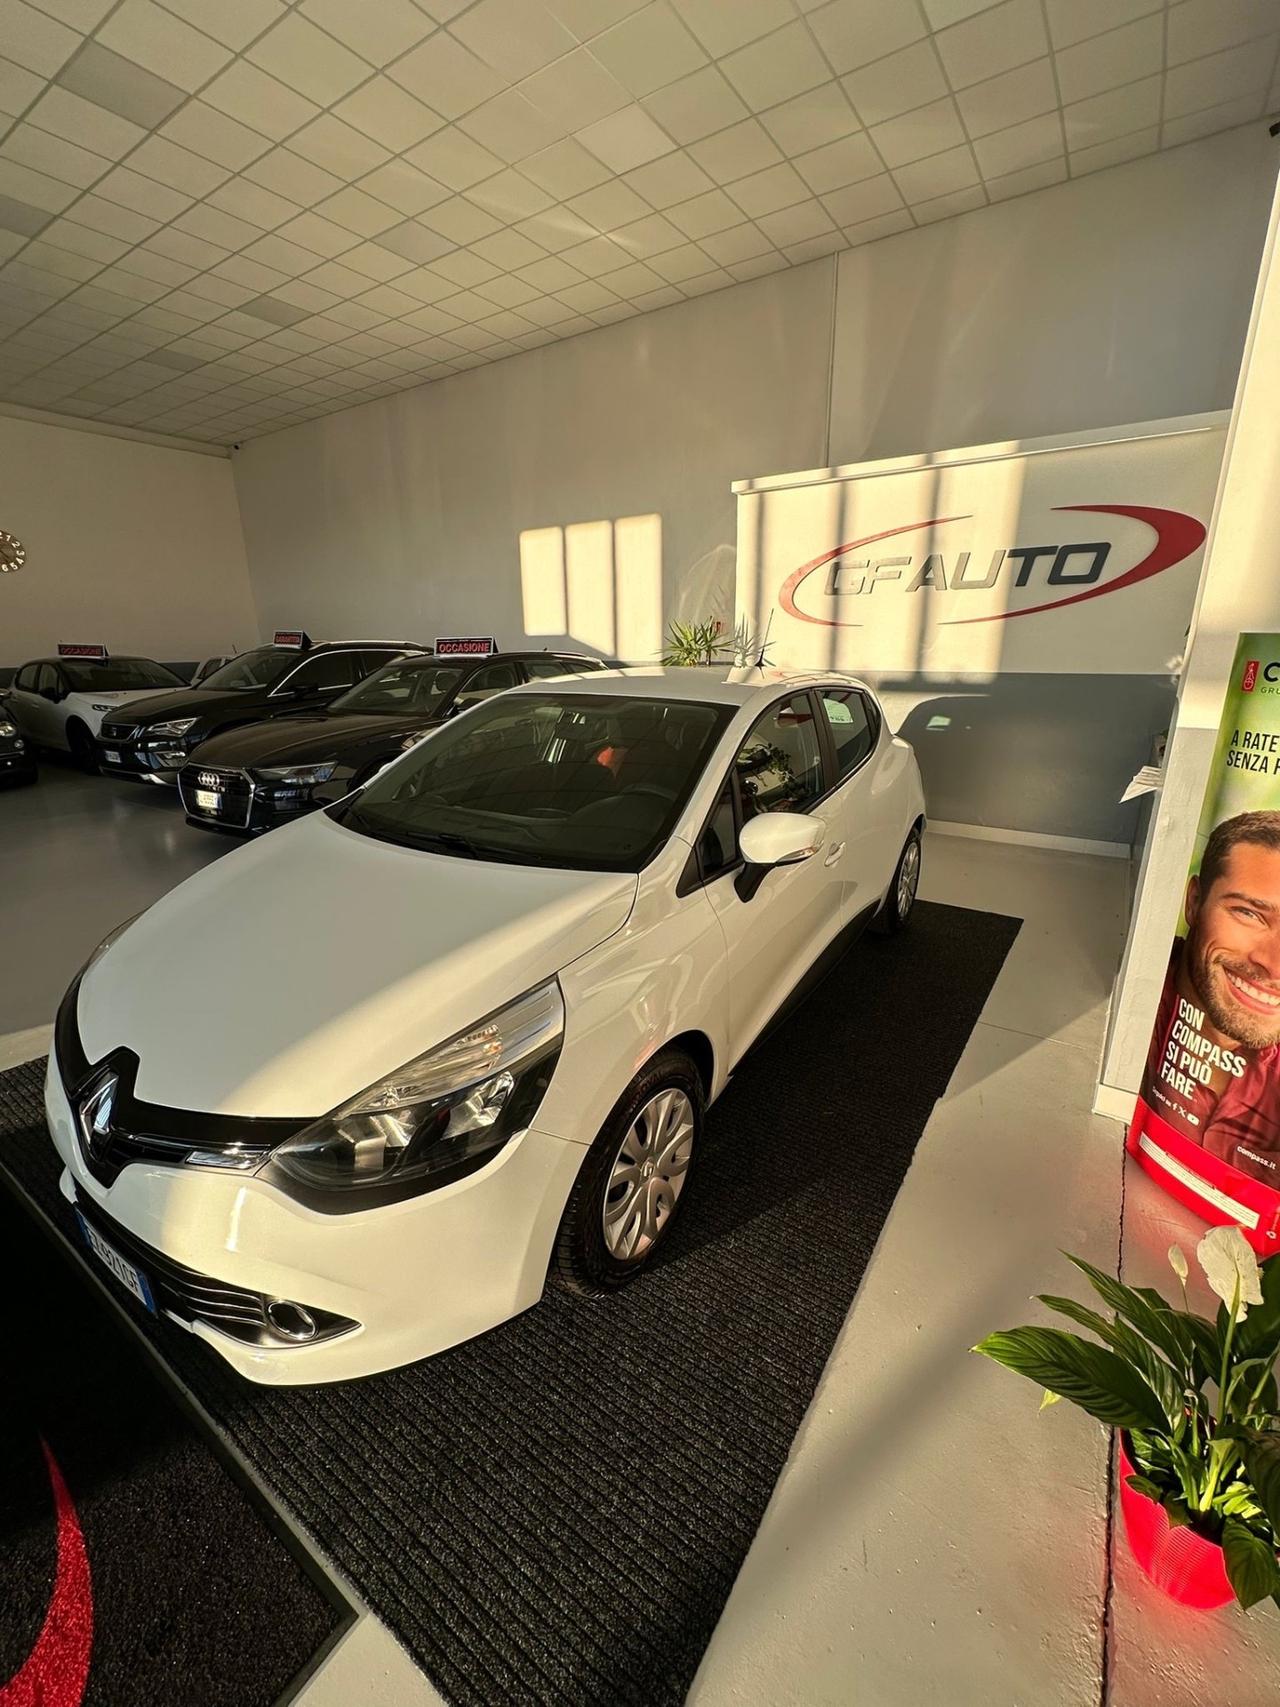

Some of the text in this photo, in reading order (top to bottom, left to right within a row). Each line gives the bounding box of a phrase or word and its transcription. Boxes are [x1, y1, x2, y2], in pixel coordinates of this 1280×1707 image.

[1, 564, 9, 572] 6
[9, 562, 18, 570] 5
[15, 557, 24, 565] 4
[439, 641, 490, 654] OCCASIONE
[1231, 730, 1280, 752] A RATE
[1226, 749, 1269, 774] SENZA
[1178, 998, 1205, 1031] CON
[1171, 1020, 1247, 1078] COMPASS
[1166, 1041, 1213, 1085] SI PUÒ
[1237, 1145, 1277, 1170] compass.it
